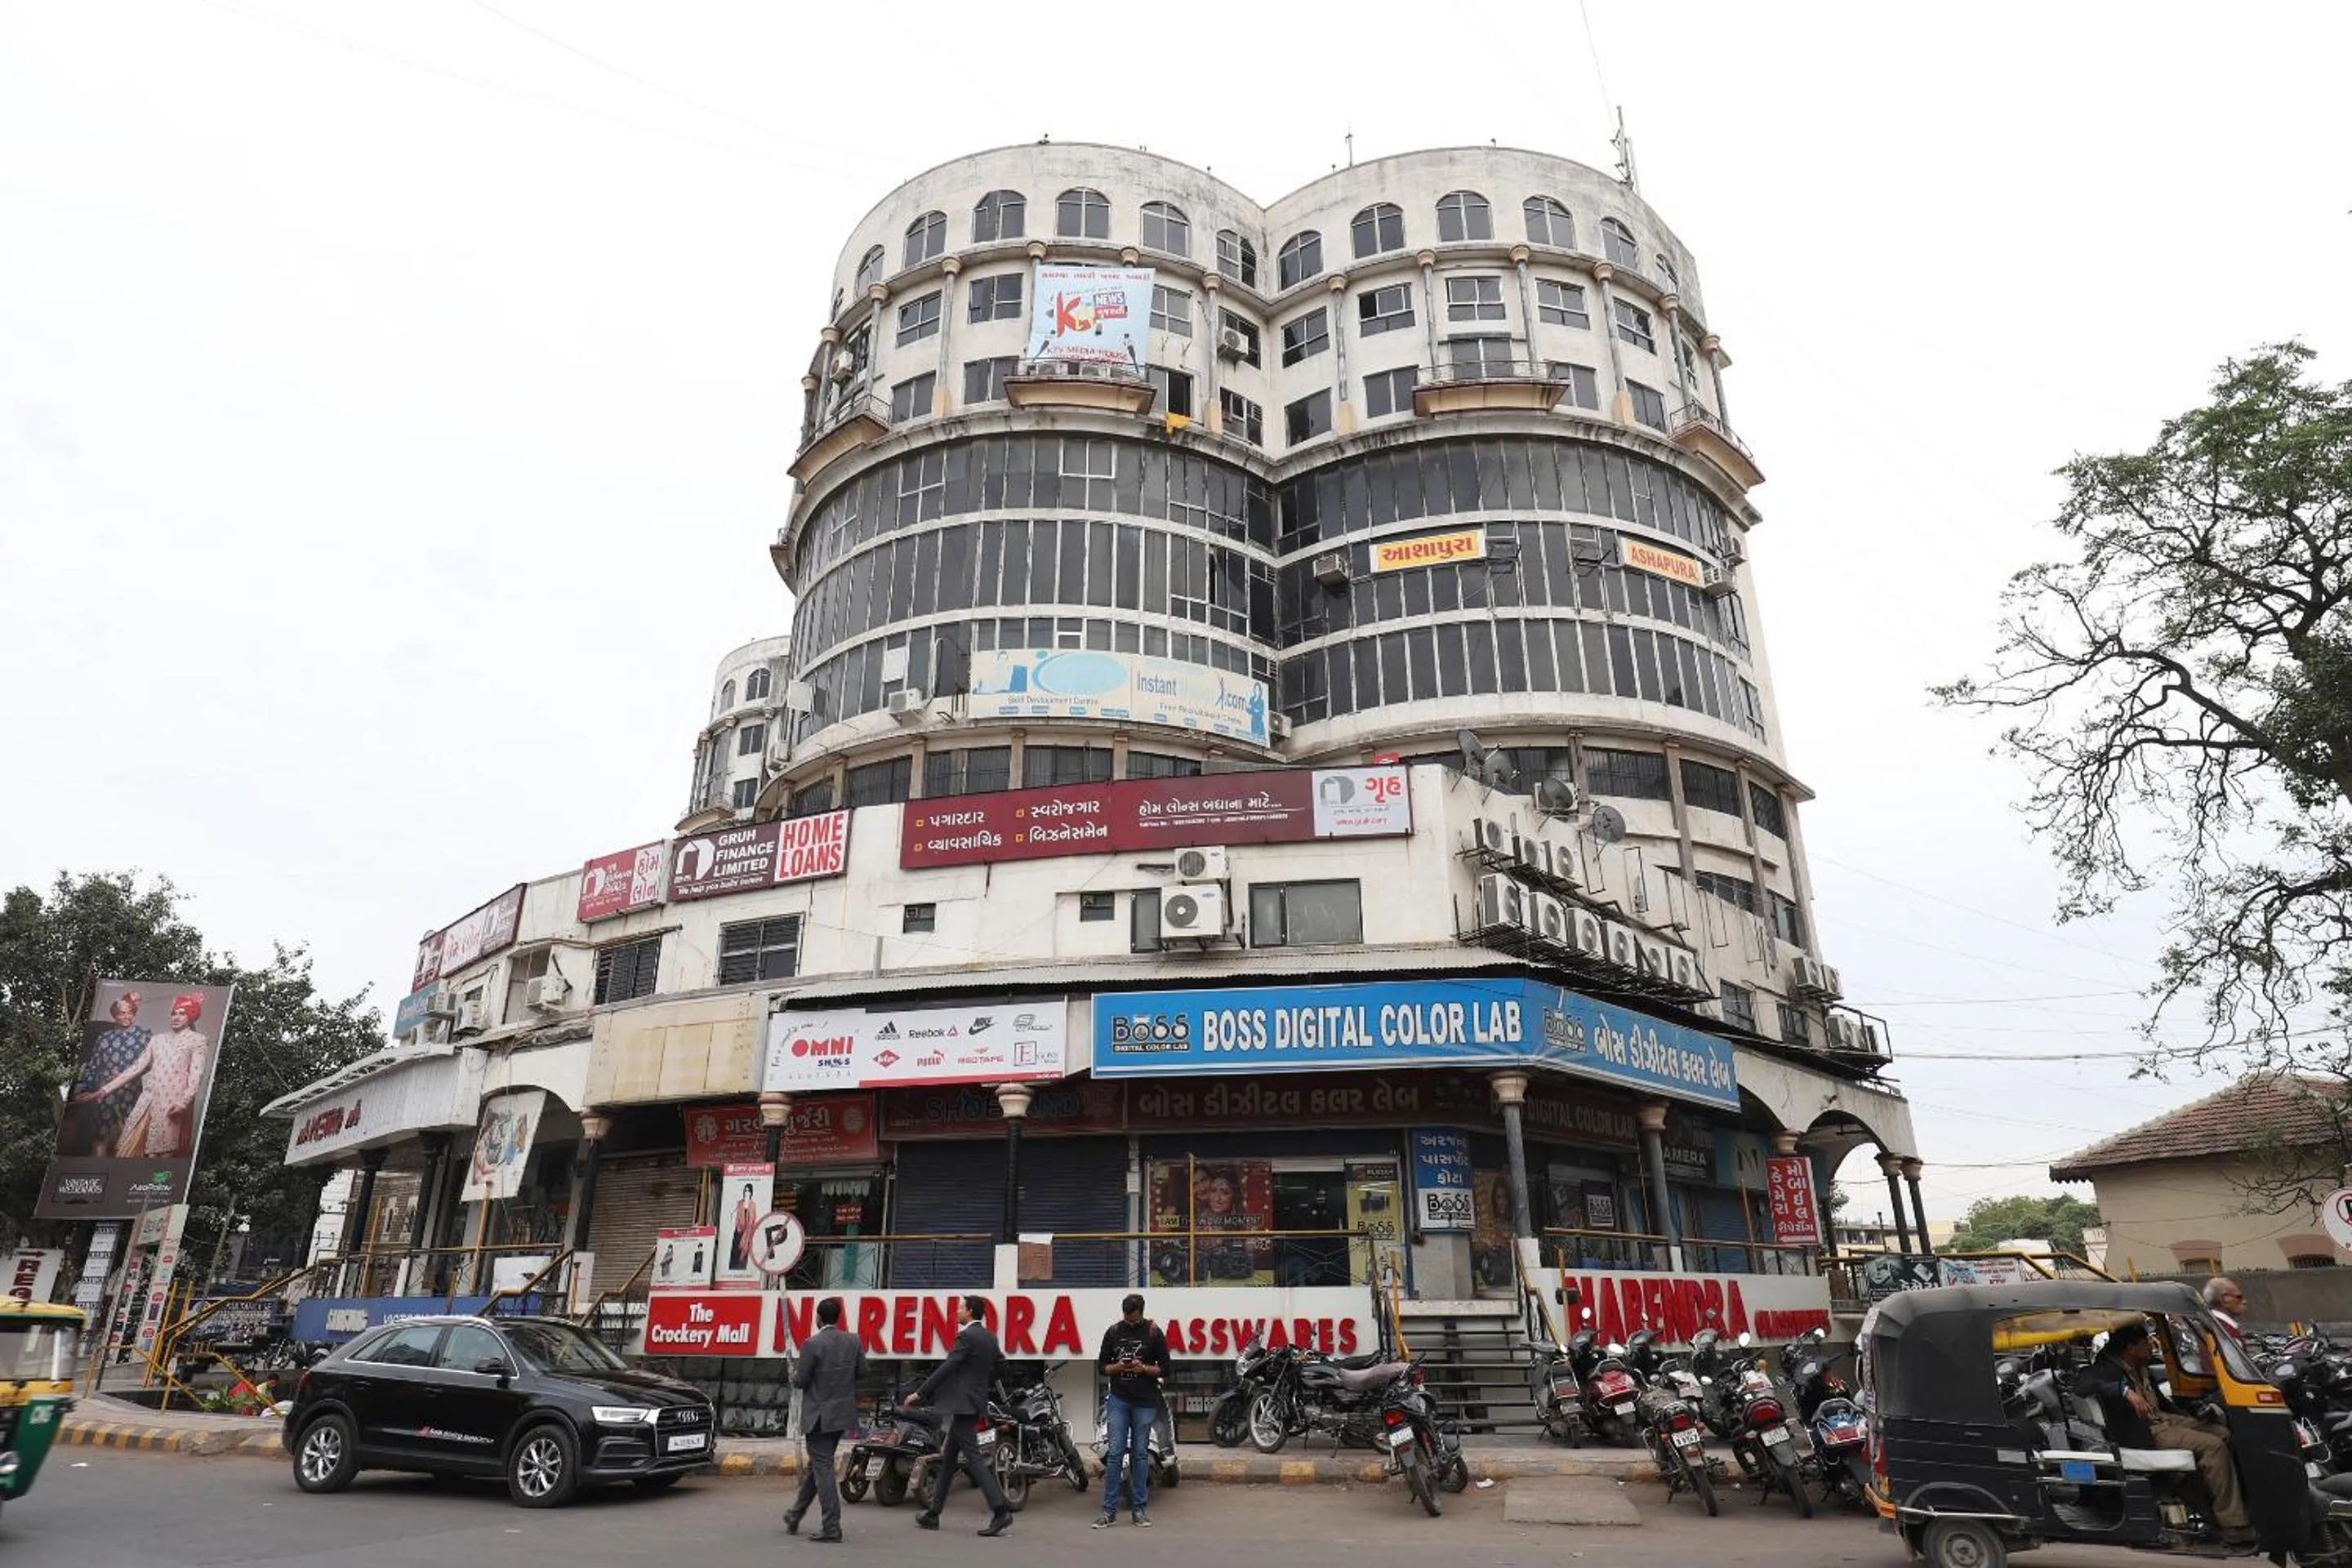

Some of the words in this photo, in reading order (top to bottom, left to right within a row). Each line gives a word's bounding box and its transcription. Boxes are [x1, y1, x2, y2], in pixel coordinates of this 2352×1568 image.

[1095, 292, 1125, 305] NEWS
[1382, 537, 1473, 559] આશાપુરા
[1630, 546, 1698, 579] ASHAPURA
[1137, 670, 1177, 696] Instant
[929, 811, 985, 826] પગારદાર
[1030, 800, 1100, 817] સ્વરોજગાર
[1139, 800, 1161, 816] હોમ
[719, 829, 756, 846] GRUH
[782, 813, 844, 851] HOME
[1029, 822, 1108, 843] બિઝનેસમેન
[716, 841, 775, 862] FINANCE
[779, 844, 842, 880] LOANS
[713, 857, 768, 877] LIMITED
[909, 1028, 945, 1039] Reebok
[1203, 1009, 1267, 1052] BOSS
[1275, 1005, 1373, 1049] DIGITAL
[1380, 1002, 1466, 1047] COLOR
[1473, 1000, 1521, 1045] LAB
[791, 1036, 853, 1057] OMNI
[1594, 1013, 1627, 1065] બોસ
[1681, 1050, 1708, 1085] કલર
[1708, 1045, 1731, 1091] લેબ
[1138, 1081, 1194, 1117] બોસ
[1310, 1088, 1366, 1114] કલર
[1372, 1078, 1419, 1112] લેબ
[1528, 1096, 1575, 1128] DIGITAL
[1575, 1105, 1614, 1135] COLOR
[1663, 1145, 1708, 1166] AMERA
[765, 1224, 788, 1259] P
[688, 1303, 714, 1323] The
[652, 1323, 714, 1348] Crockery
[716, 1322, 751, 1344] Mall
